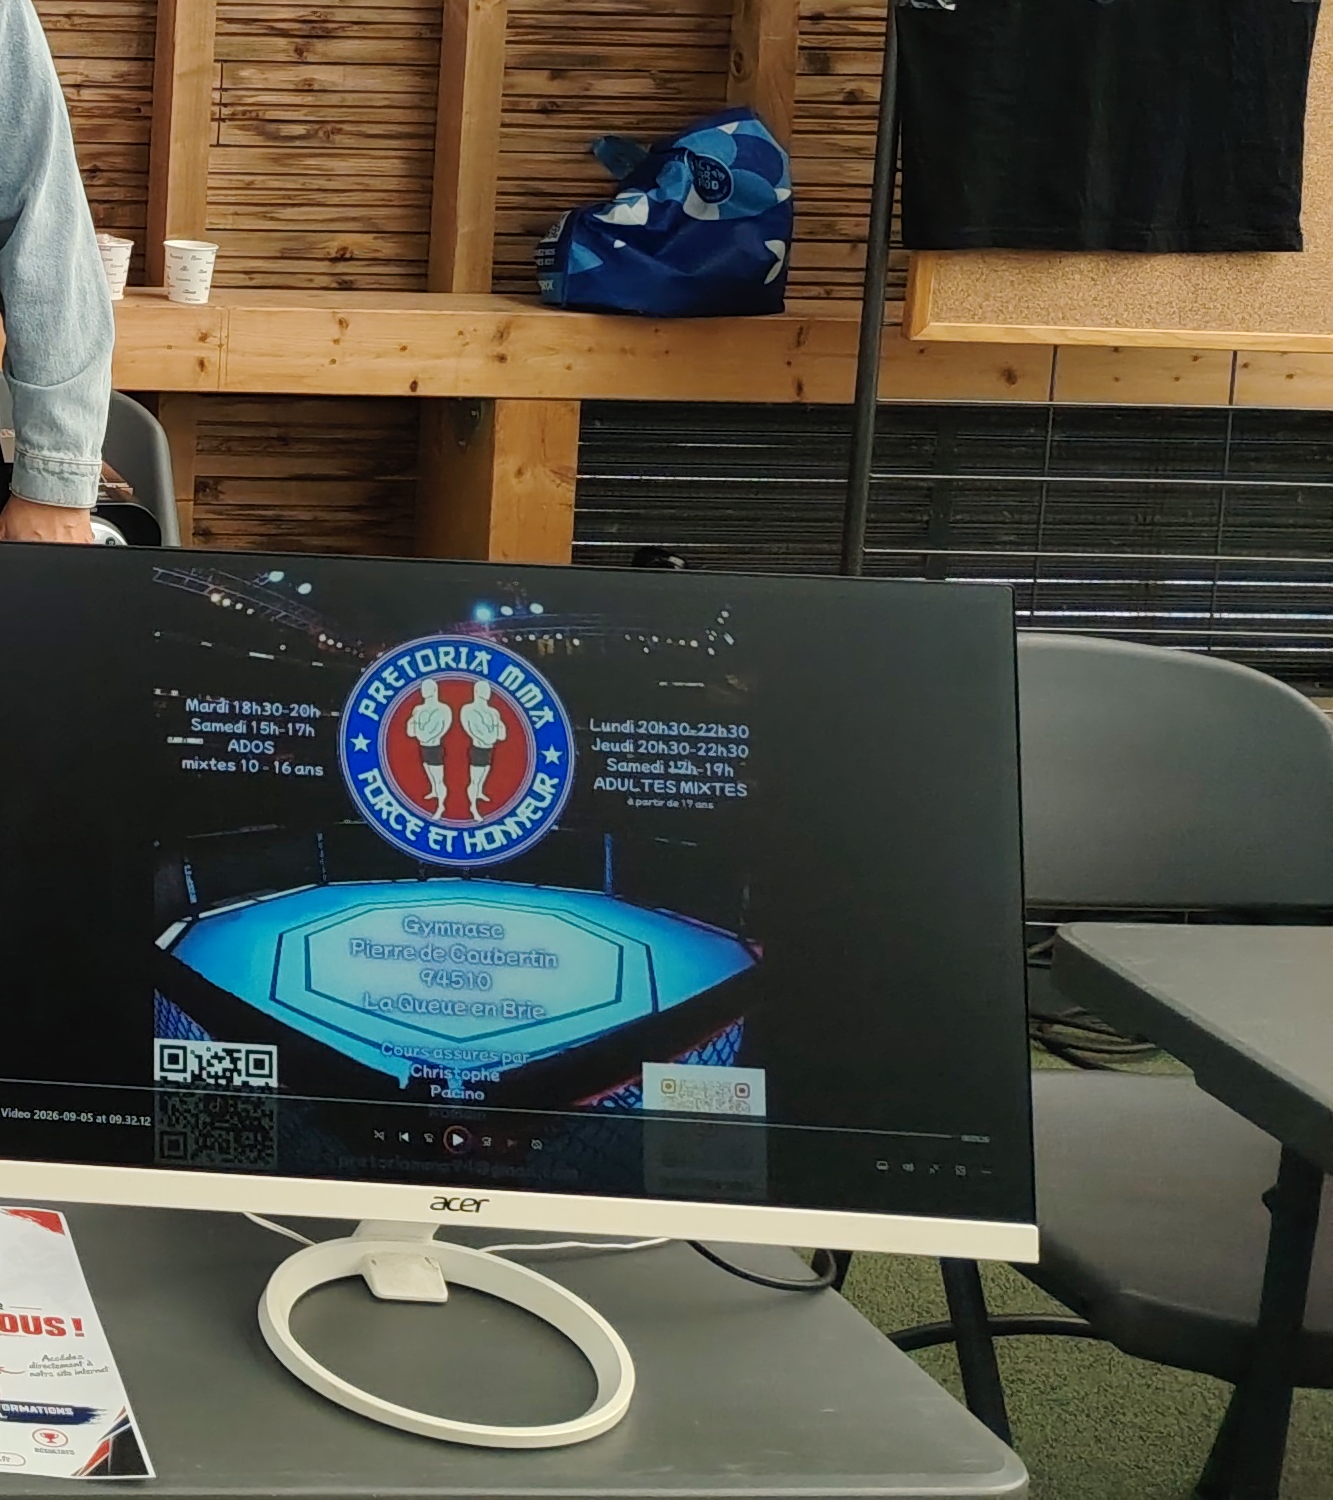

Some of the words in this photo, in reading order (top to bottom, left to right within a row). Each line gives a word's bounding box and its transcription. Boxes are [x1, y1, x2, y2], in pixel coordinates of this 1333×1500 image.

[358, 647, 492, 721] PRETORIA
[497, 664, 555, 729] MMA
[185, 699, 229, 714] Mardi
[233, 701, 320, 718] 18h30-20h
[191, 718, 247, 733] Samedi
[251, 721, 315, 737] 15h-17h
[589, 718, 634, 734] Lundi
[636, 720, 749, 739] 20h30-22h30
[228, 739, 275, 754] ADOS
[591, 738, 634, 753] Jeudi
[637, 740, 749, 758] 20h30-22h30
[182, 757, 236, 771] mixtes
[241, 760, 259, 773] 10
[274, 761, 291, 774] 16
[294, 765, 324, 776] ans
[606, 757, 665, 774] Samedi
[593, 777, 676, 794] ADULTES
[680, 781, 748, 797] MIXTES
[358, 767, 424, 840] FORCE
[428, 826, 458, 853] ET
[463, 772, 559, 854] HONNEUR
[403, 915, 504, 939] Gymnase
[350, 938, 415, 961] Pierre
[420, 943, 446, 962] de
[450, 944, 558, 968] Coubertin
[420, 969, 492, 991] 94510
[363, 992, 393, 1012] La
[397, 994, 467, 1016] Queue
[471, 1002, 497, 1018] en
[502, 1000, 546, 1020] Brie
[382, 1042, 429, 1058] Cours
[501, 1052, 529, 1067] par
[410, 1063, 501, 1084] Christophe
[429, 1084, 485, 1101] Pacino
[1, 1108, 31, 1119] Video
[33, 1110, 94, 1123] 2026-09-05
[96, 1113, 107, 1124] at
[109, 1115, 152, 1126] 09.32.12
[429, 1196, 489, 1214] acer
